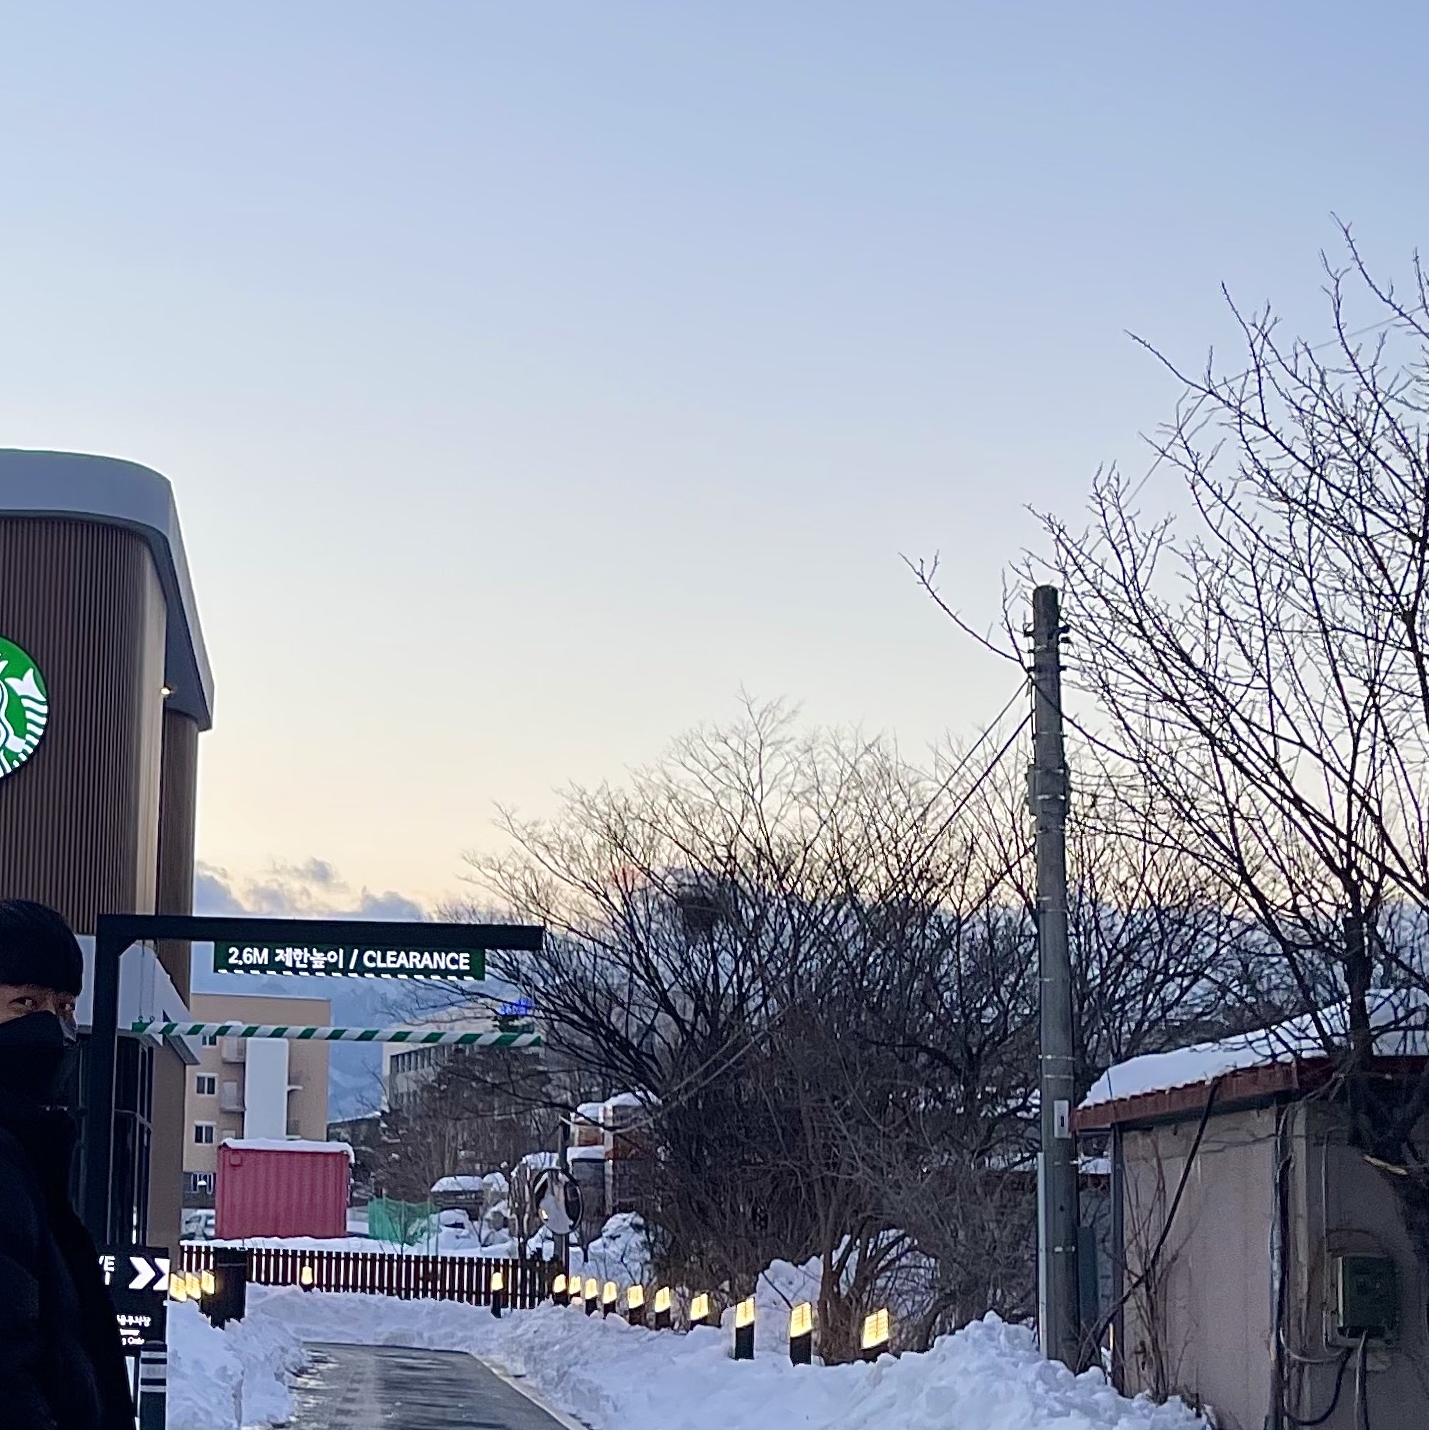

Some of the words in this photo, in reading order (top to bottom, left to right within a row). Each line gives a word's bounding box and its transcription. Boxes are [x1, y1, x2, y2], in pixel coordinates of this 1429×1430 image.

[228, 947, 269, 966] 2.6M
[274, 947, 344, 969] 제한높이
[362, 950, 471, 971] CLEARANCE
